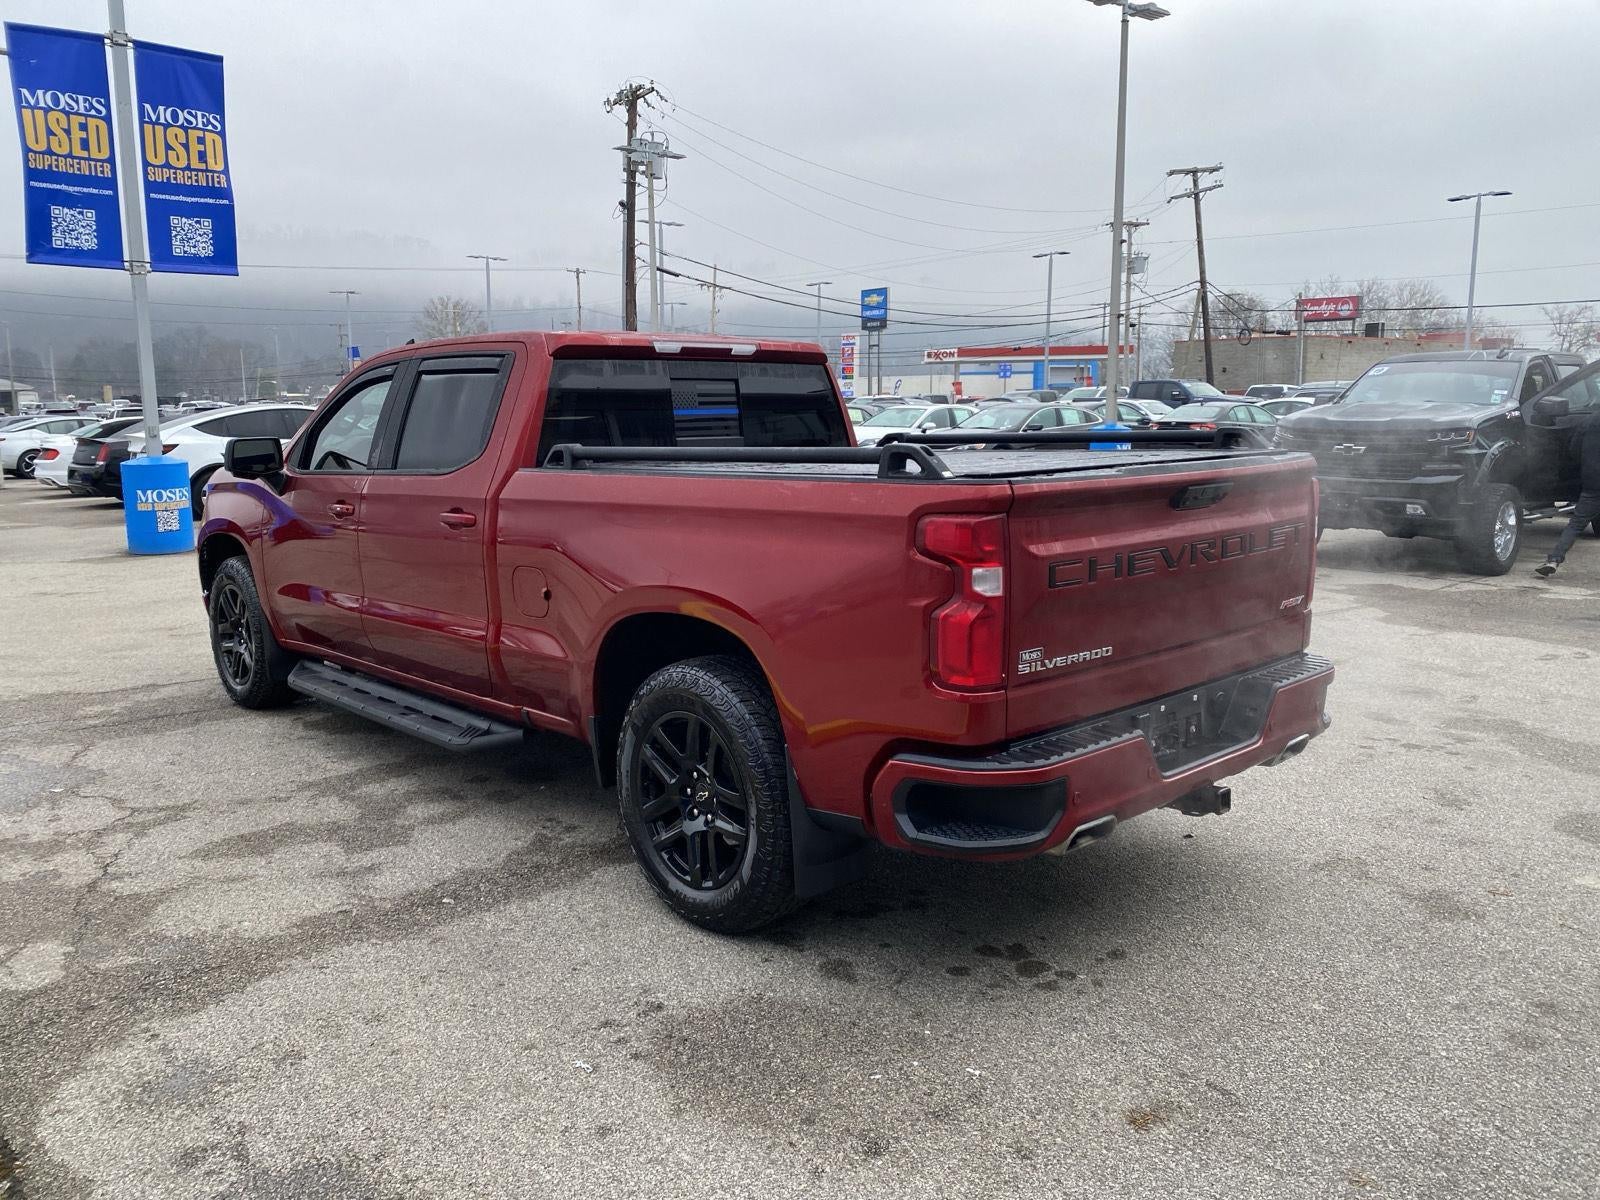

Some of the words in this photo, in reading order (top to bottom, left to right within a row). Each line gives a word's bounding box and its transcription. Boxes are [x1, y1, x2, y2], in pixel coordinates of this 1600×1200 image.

[18, 87, 107, 117] MOSES
[142, 102, 222, 132] MOSES
[21, 108, 110, 160] USED
[143, 123, 225, 172] USED
[28, 152, 112, 178] SUPERCENTER
[147, 166, 227, 188] SUPERCENTER
[29, 181, 113, 196] mosesusedsupercenter.com
[149, 193, 229, 205] mosesusedsupercenter.com
[926, 350, 956, 361] EXXON
[136, 486, 189, 503] MOSES
[1048, 523, 1305, 589] CHEVROLET
[1017, 646, 1113, 675] SILVERADO
